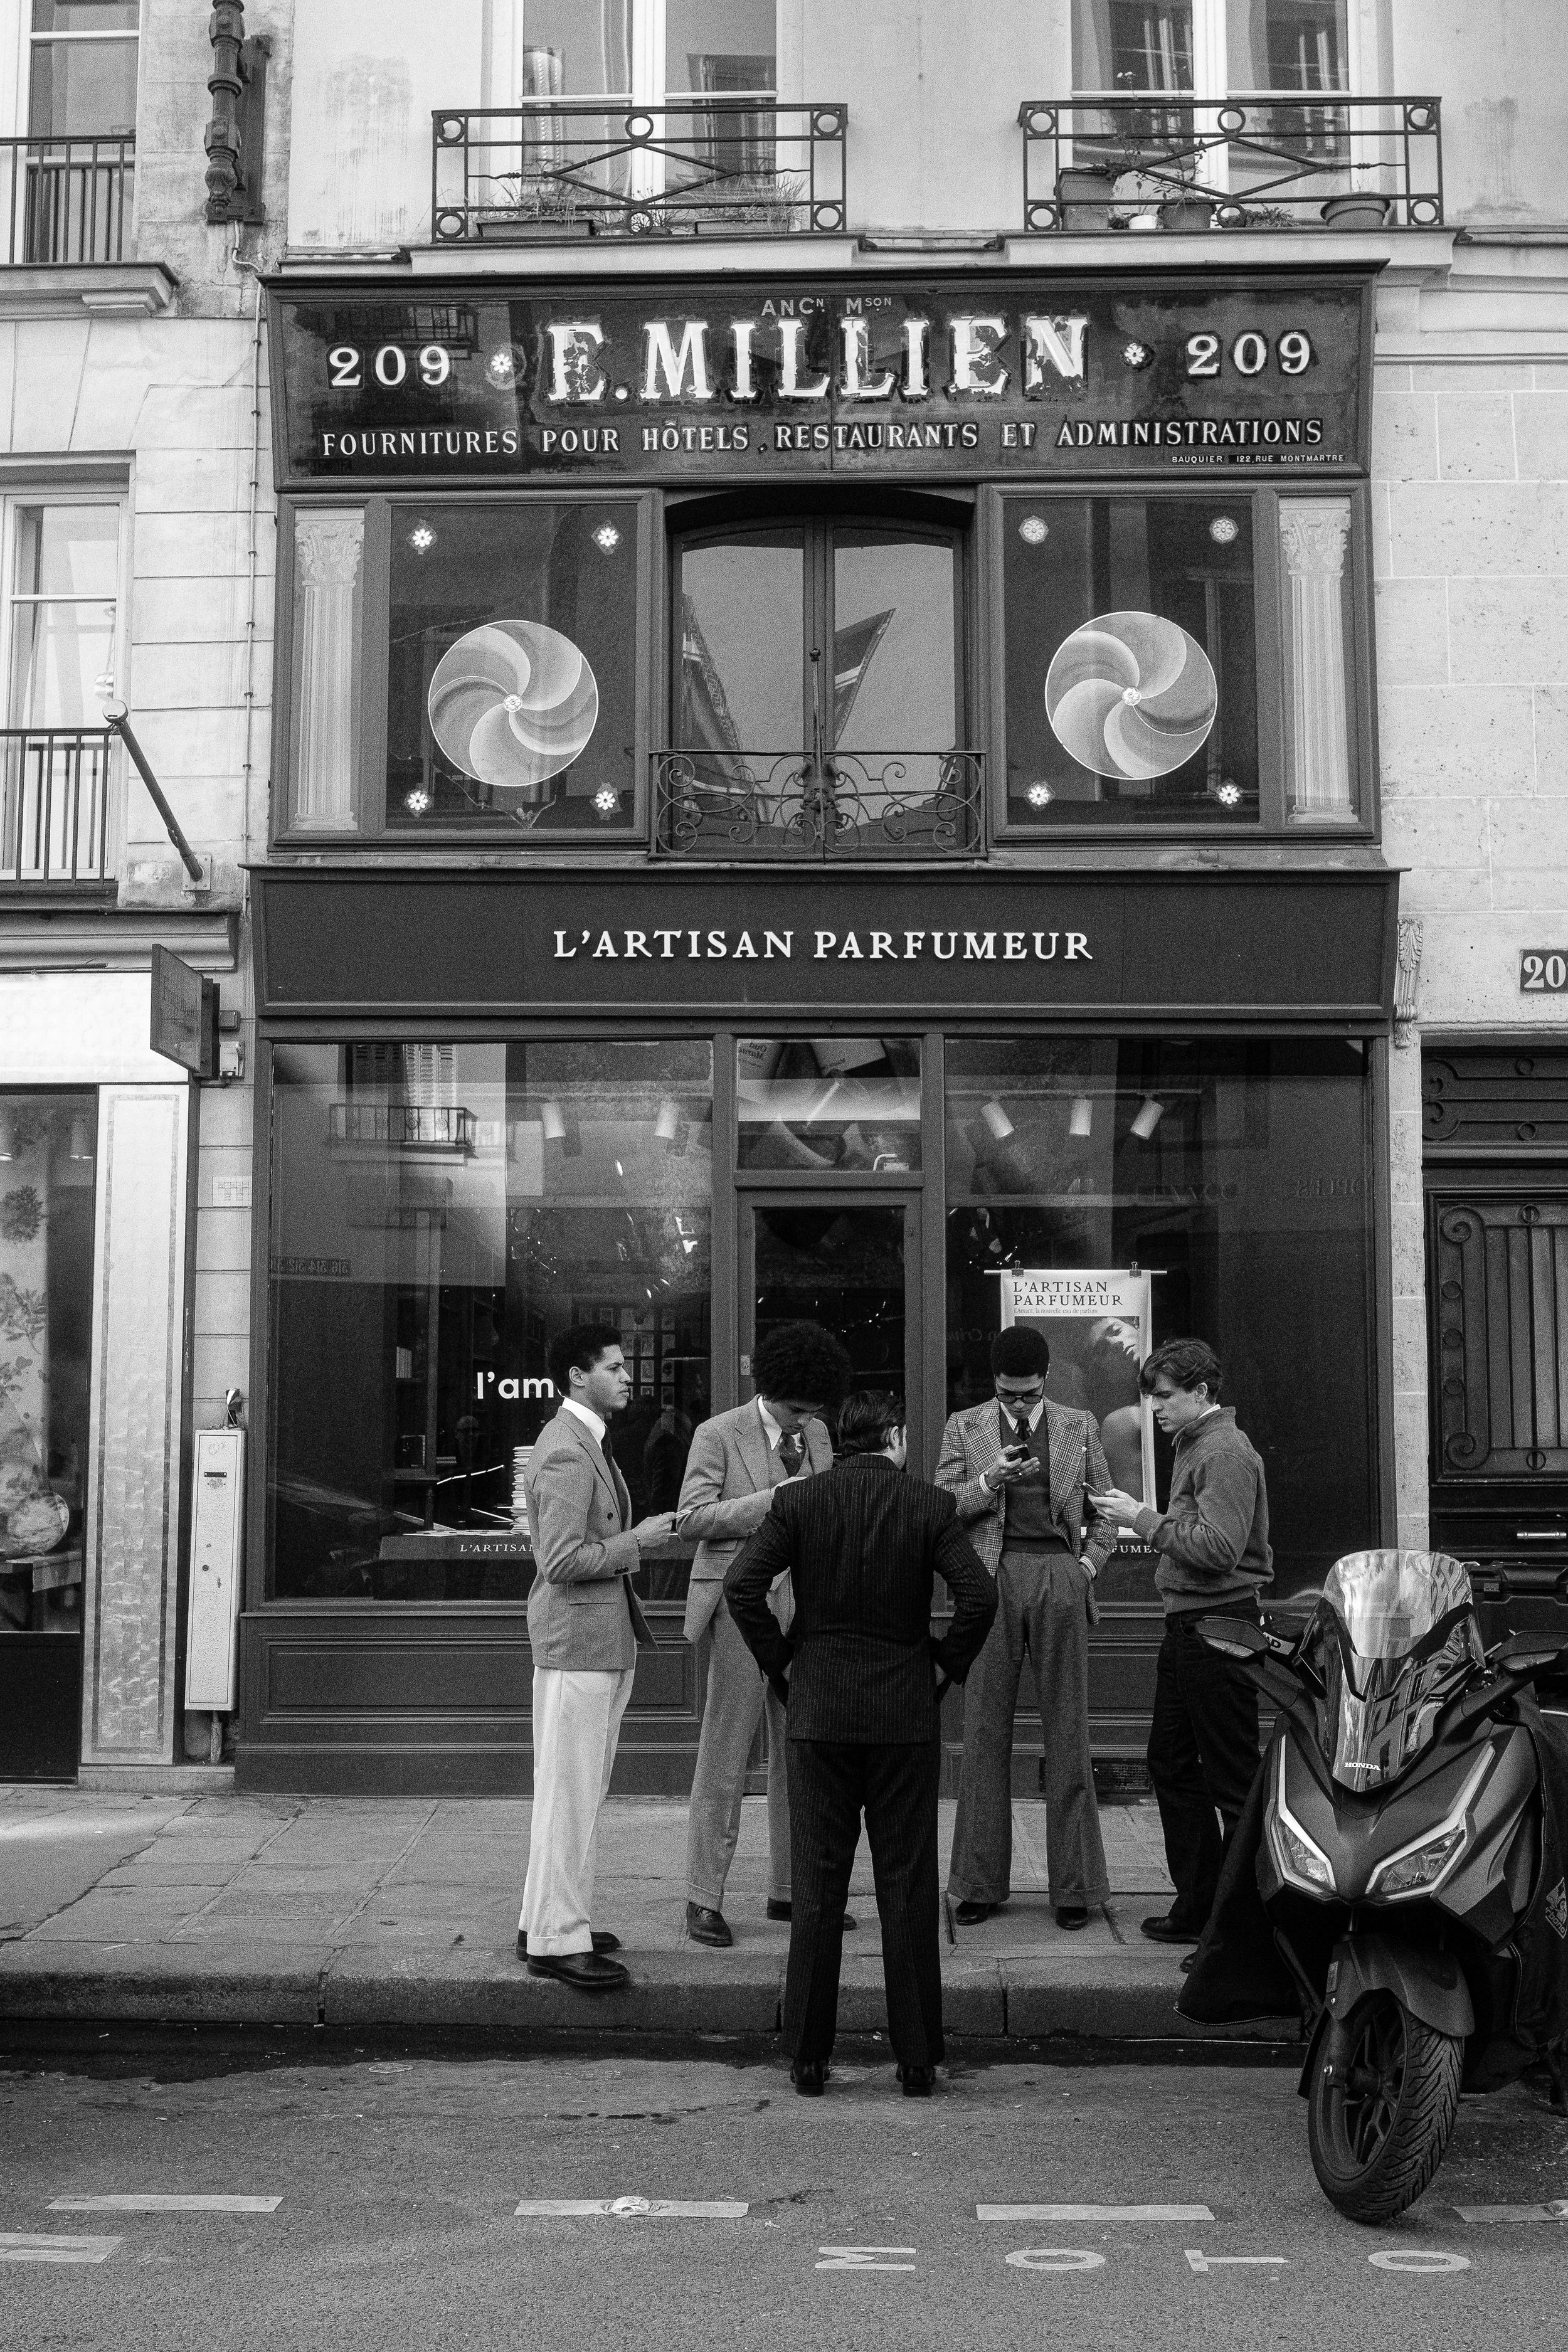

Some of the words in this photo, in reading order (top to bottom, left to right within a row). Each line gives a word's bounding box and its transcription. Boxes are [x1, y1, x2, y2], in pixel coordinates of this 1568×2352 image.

[1187, 332, 1310, 375] 209
[328, 346, 451, 387] 209
[322, 430, 518, 455] FOURNITURES
[543, 428, 619, 452] POUR
[775, 423, 979, 448] RESTAURANTS
[1002, 423, 1034, 446] ET
[1056, 419, 1323, 446] ADMINISTRATIONS
[1172, 456, 1222, 464] BAUQUIER
[1280, 454, 1344, 462] MONTMARTRE
[553, 930, 794, 958] L'ARTISAN
[813, 930, 1093, 960] PARFUMEUR
[1014, 1281, 1108, 1292] L'ARTISAN
[1014, 1295, 1123, 1306] PARFUMEUR
[1344, 1762, 1381, 1771] HONDA
